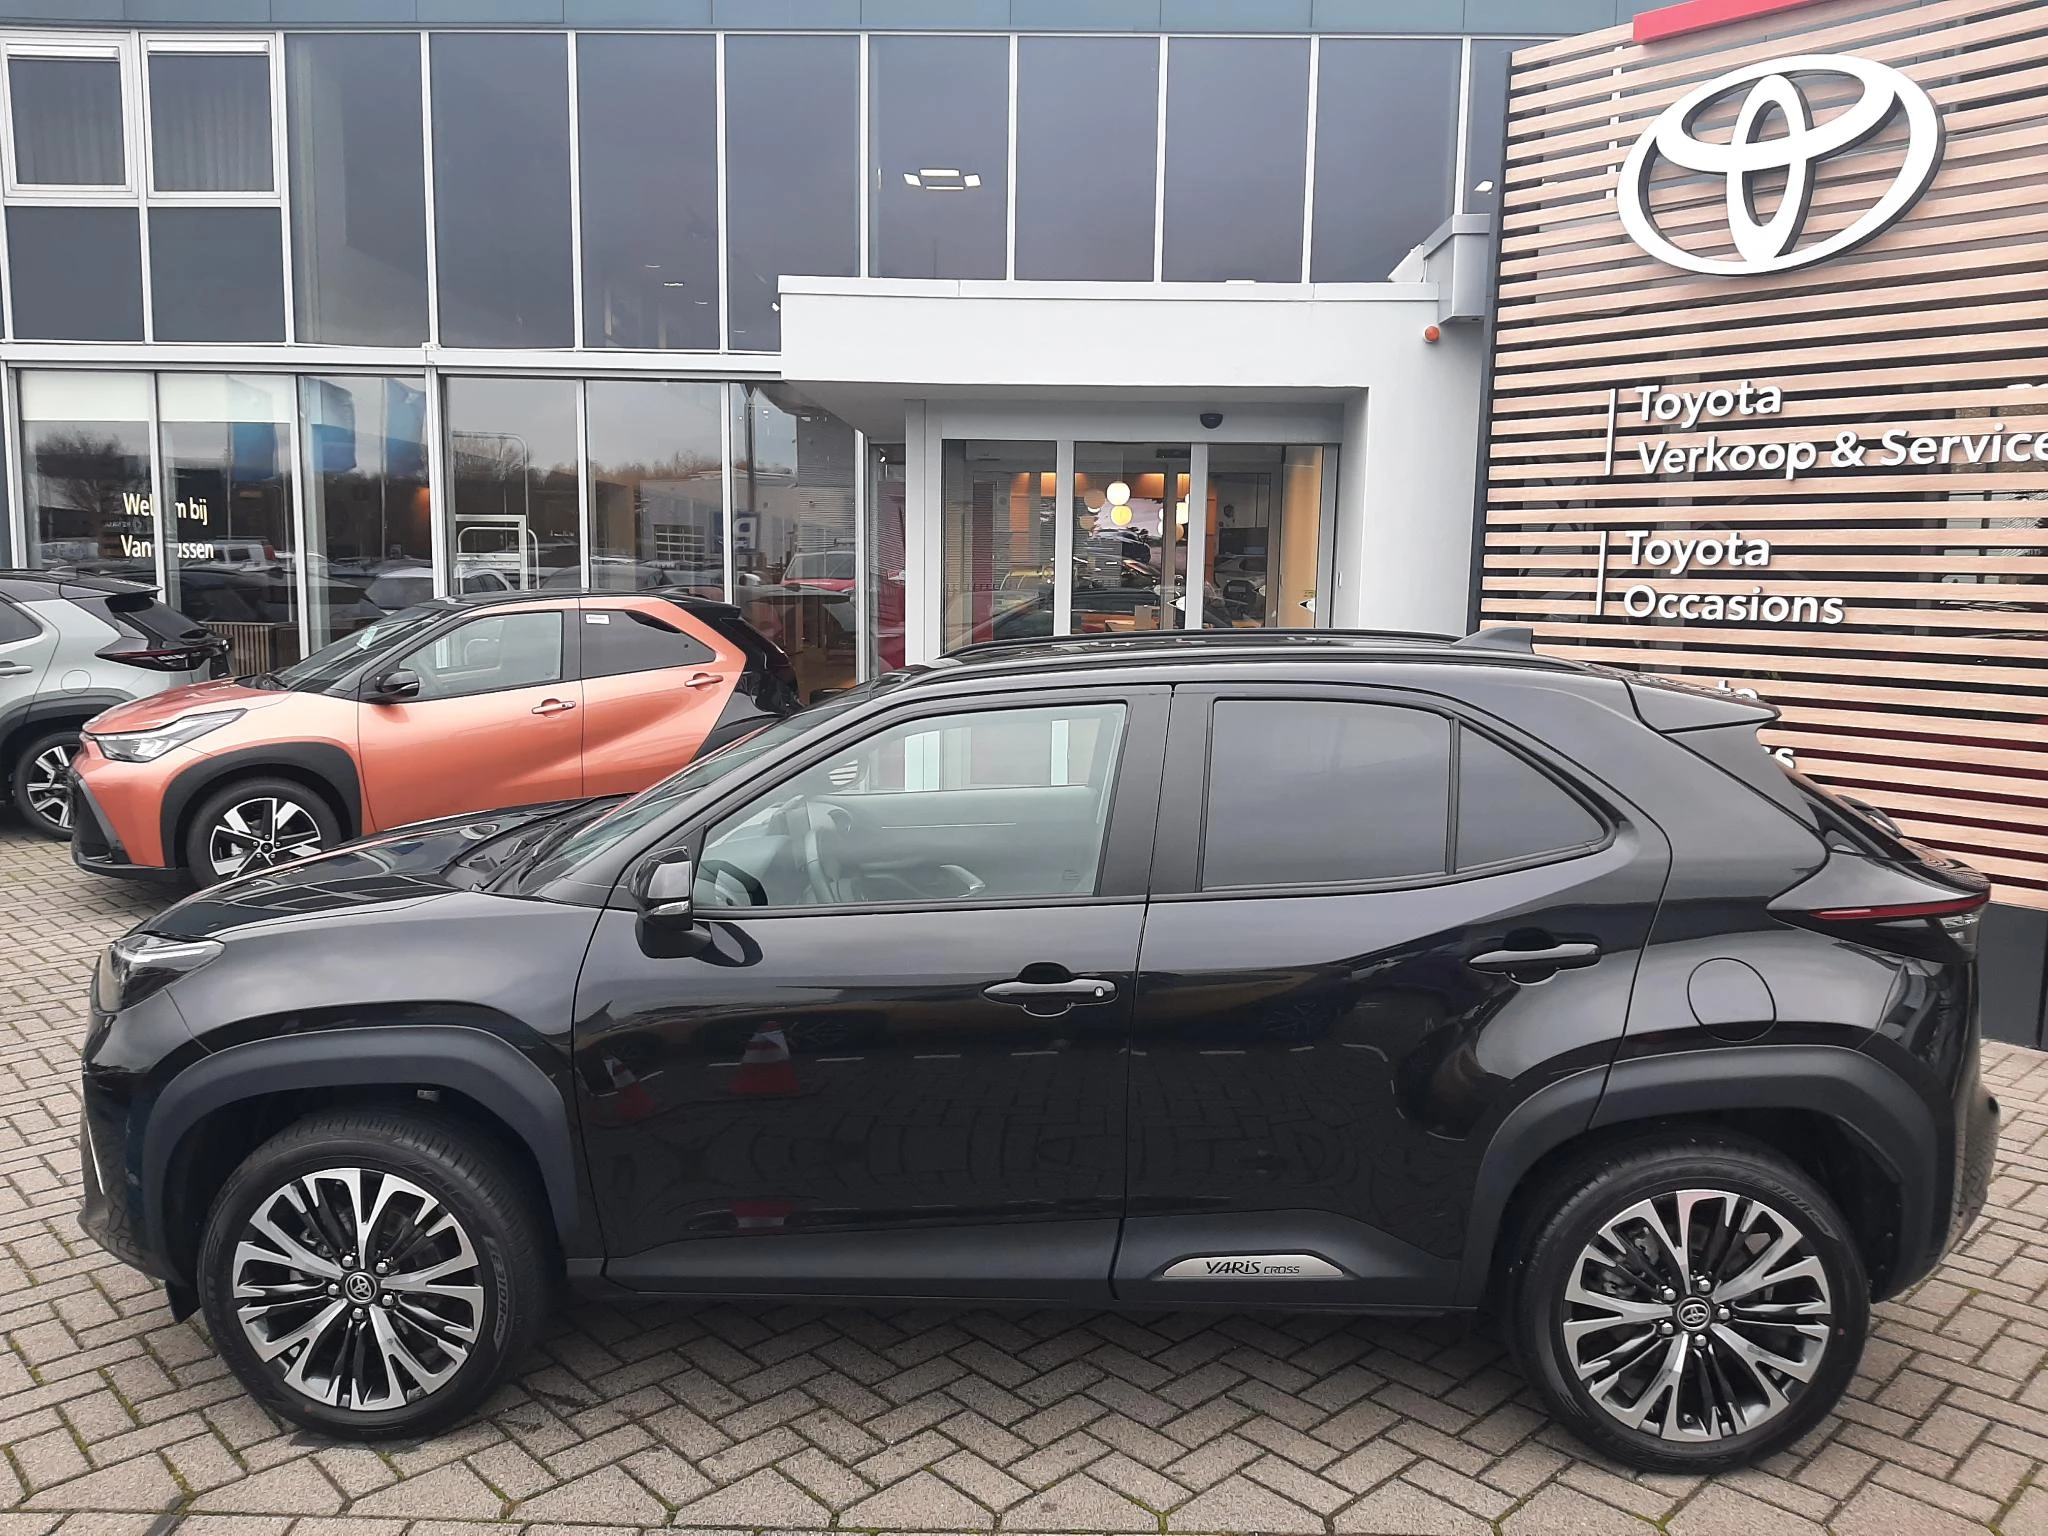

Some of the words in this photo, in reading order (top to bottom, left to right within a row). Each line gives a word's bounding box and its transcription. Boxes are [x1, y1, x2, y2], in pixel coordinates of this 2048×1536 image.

[1635, 380, 1783, 429] Toyota
[1638, 435, 1817, 480] Verkoop
[1831, 431, 1865, 467] &
[123, 492, 187, 519] Welm
[189, 496, 208, 525] bij
[120, 534, 152, 558] Van
[1625, 530, 1771, 575] Toyota
[1623, 585, 1844, 625] Occasions
[1263, 1266, 1300, 1274] CROSS
